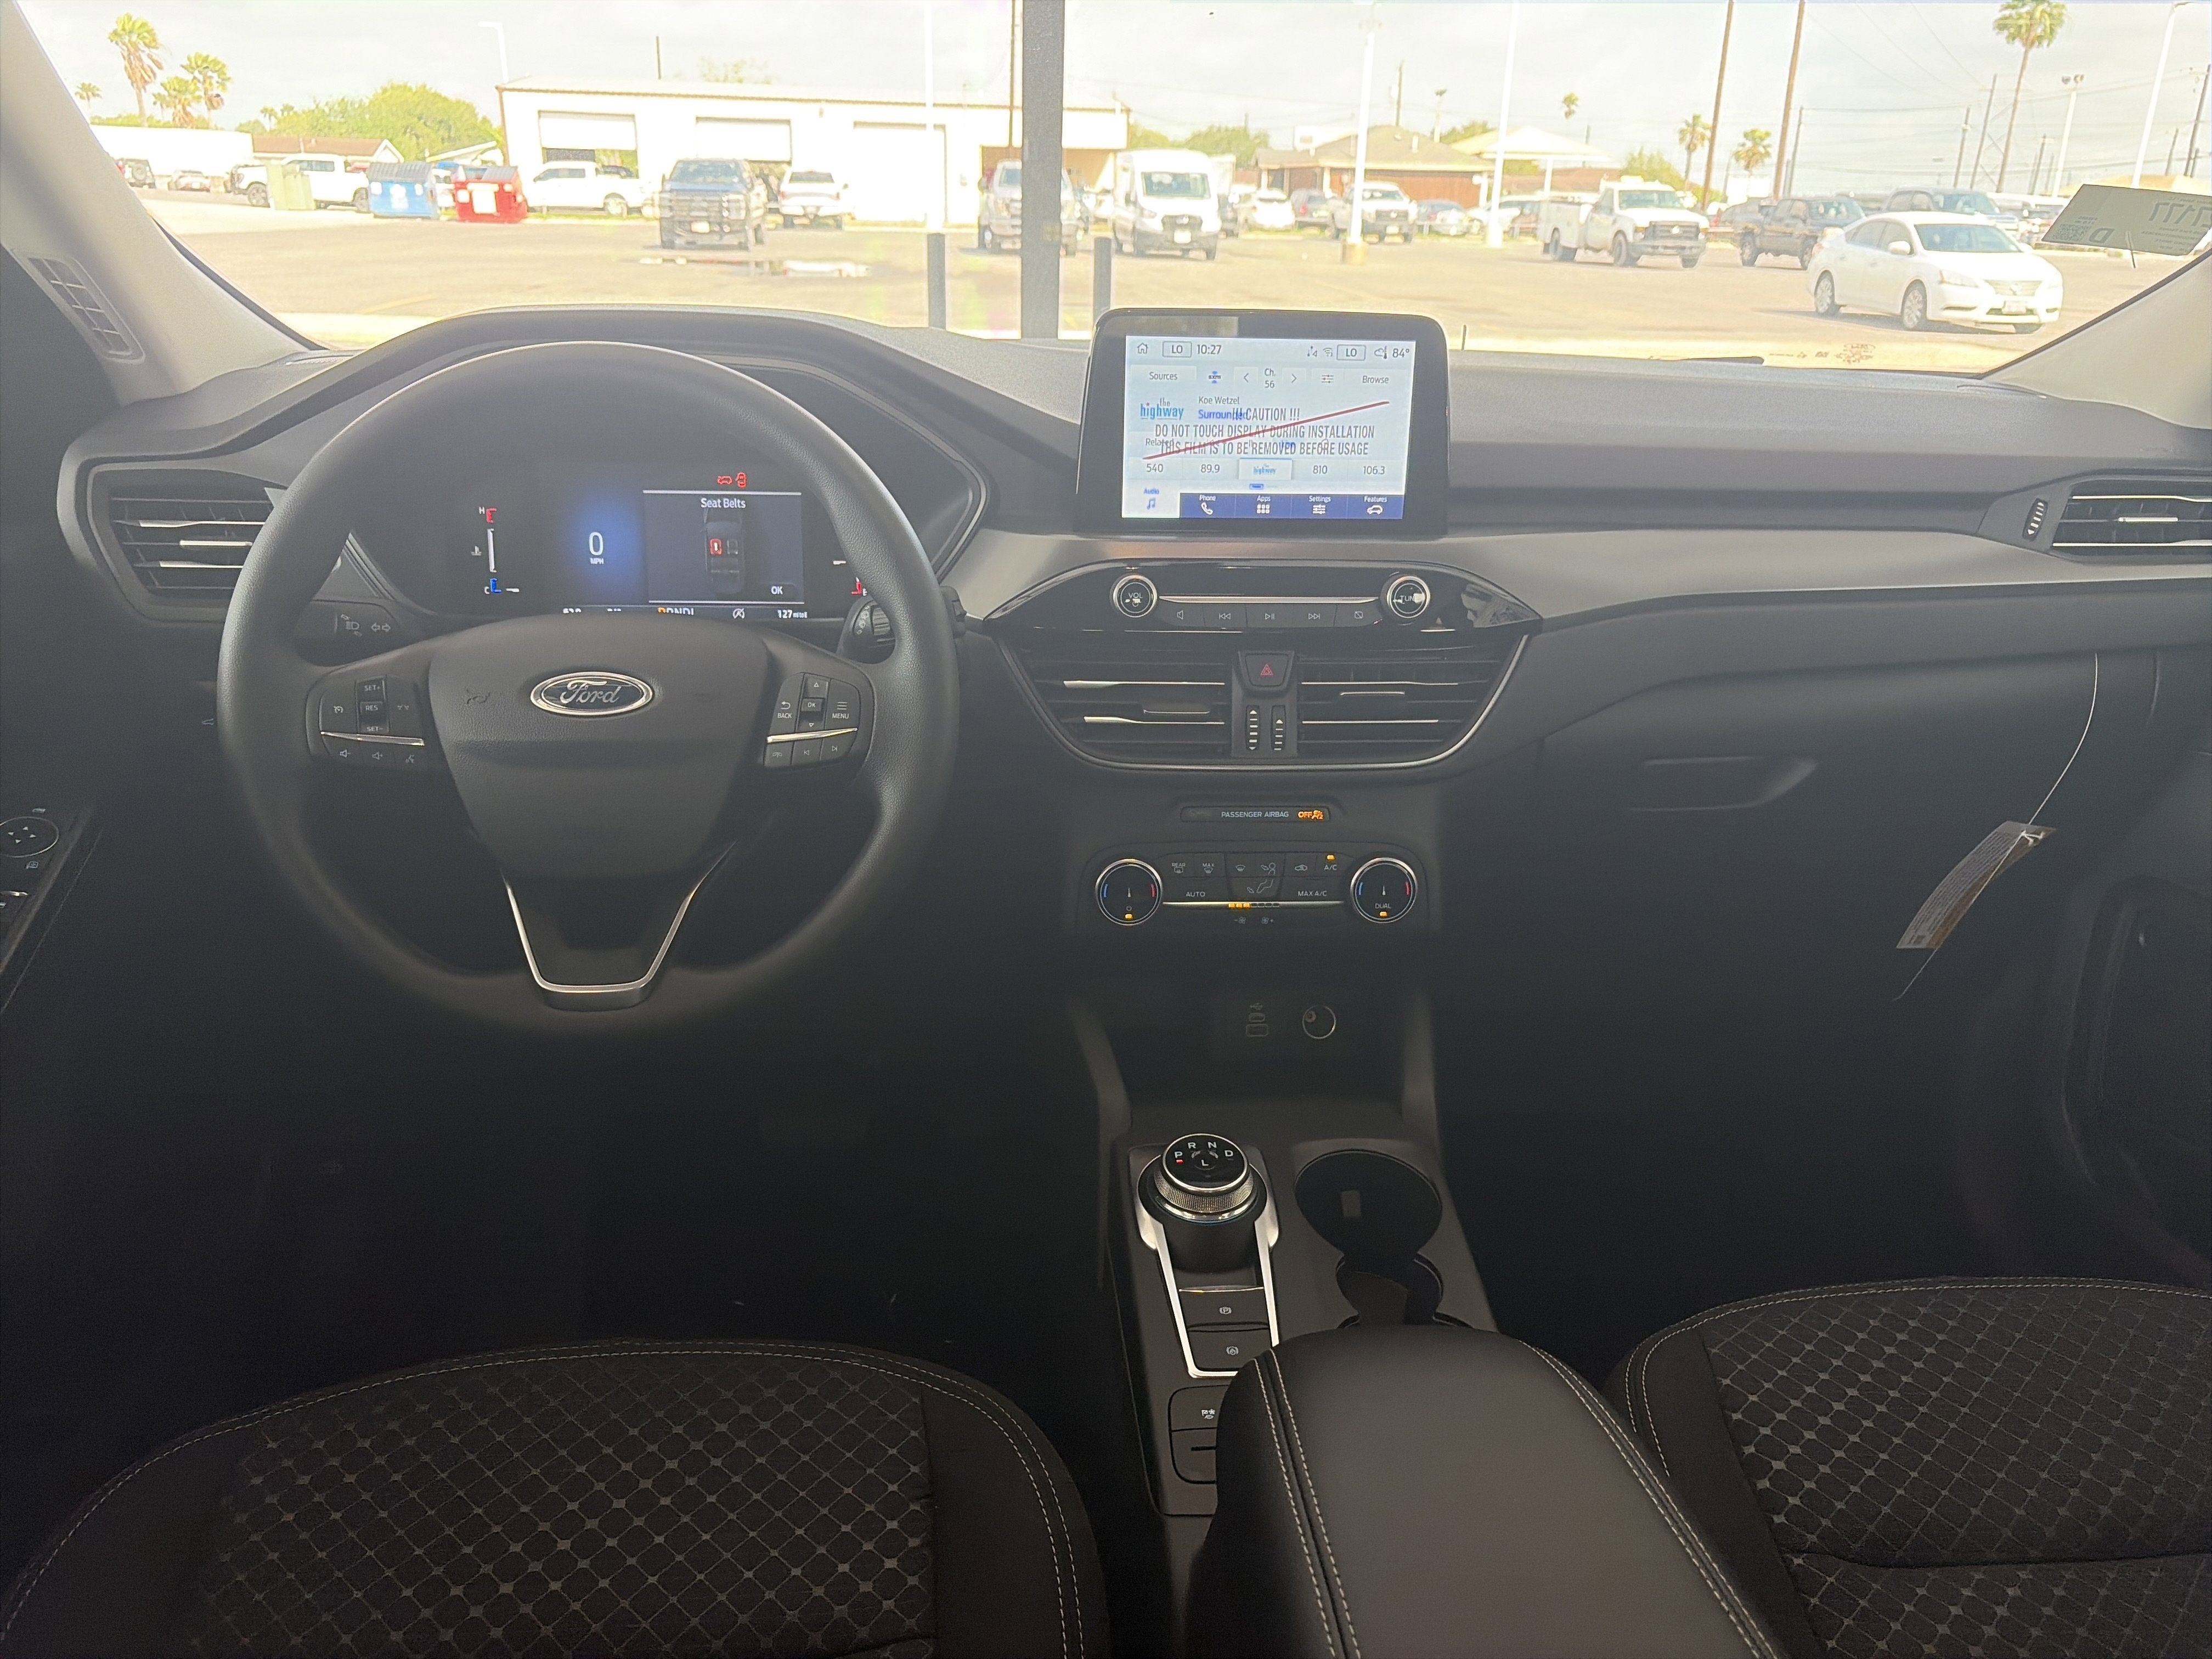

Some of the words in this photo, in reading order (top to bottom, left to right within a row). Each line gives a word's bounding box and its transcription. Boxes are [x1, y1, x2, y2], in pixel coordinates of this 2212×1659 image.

[1171, 345, 1183, 354] LO
[1197, 345, 1222, 354] 10:27
[1346, 348, 1357, 357] LO
[1392, 348, 1410, 358] 84°
[1149, 372, 1178, 380] Sources
[1264, 368, 1276, 376] Ch.
[1362, 375, 1389, 383] Browse
[1264, 380, 1275, 388] 56
[1160, 398, 1171, 407] the
[1198, 396, 1213, 404] Koe
[1215, 396, 1240, 405] Wetzel
[1140, 403, 1184, 420] highway
[1246, 408, 1286, 421] CAUTION
[1155, 424, 1168, 437] DO
[1172, 424, 1190, 438] NOT
[1193, 424, 1224, 438] TOUCH
[1227, 425, 1267, 438] DISPLAY
[1270, 425, 1305, 438] DURING
[1308, 425, 1375, 438] INSTALLATION
[1146, 438, 1174, 446] Related
[1160, 441, 1181, 454] THIS
[1184, 442, 1206, 455] FILM
[1209, 442, 1219, 455] IS
[1222, 442, 1233, 455] TO
[1237, 442, 1249, 455] BE
[1251, 442, 1296, 455] REMOVED
[1300, 442, 1335, 455] BEFORE
[1338, 442, 1369, 456] USAGE
[1146, 464, 1164, 473] 540
[1200, 464, 1220, 473] 89.9
[1312, 465, 1328, 475] 810
[1363, 466, 1385, 475] 106.3
[701, 498, 722, 508] Seat
[723, 498, 746, 509] Belts
[478, 506, 486, 515] H
[589, 531, 604, 556] 0
[484, 586, 490, 595] C
[771, 586, 783, 595] OK
[777, 609, 793, 619] 127
[560, 679, 622, 704] Ford
